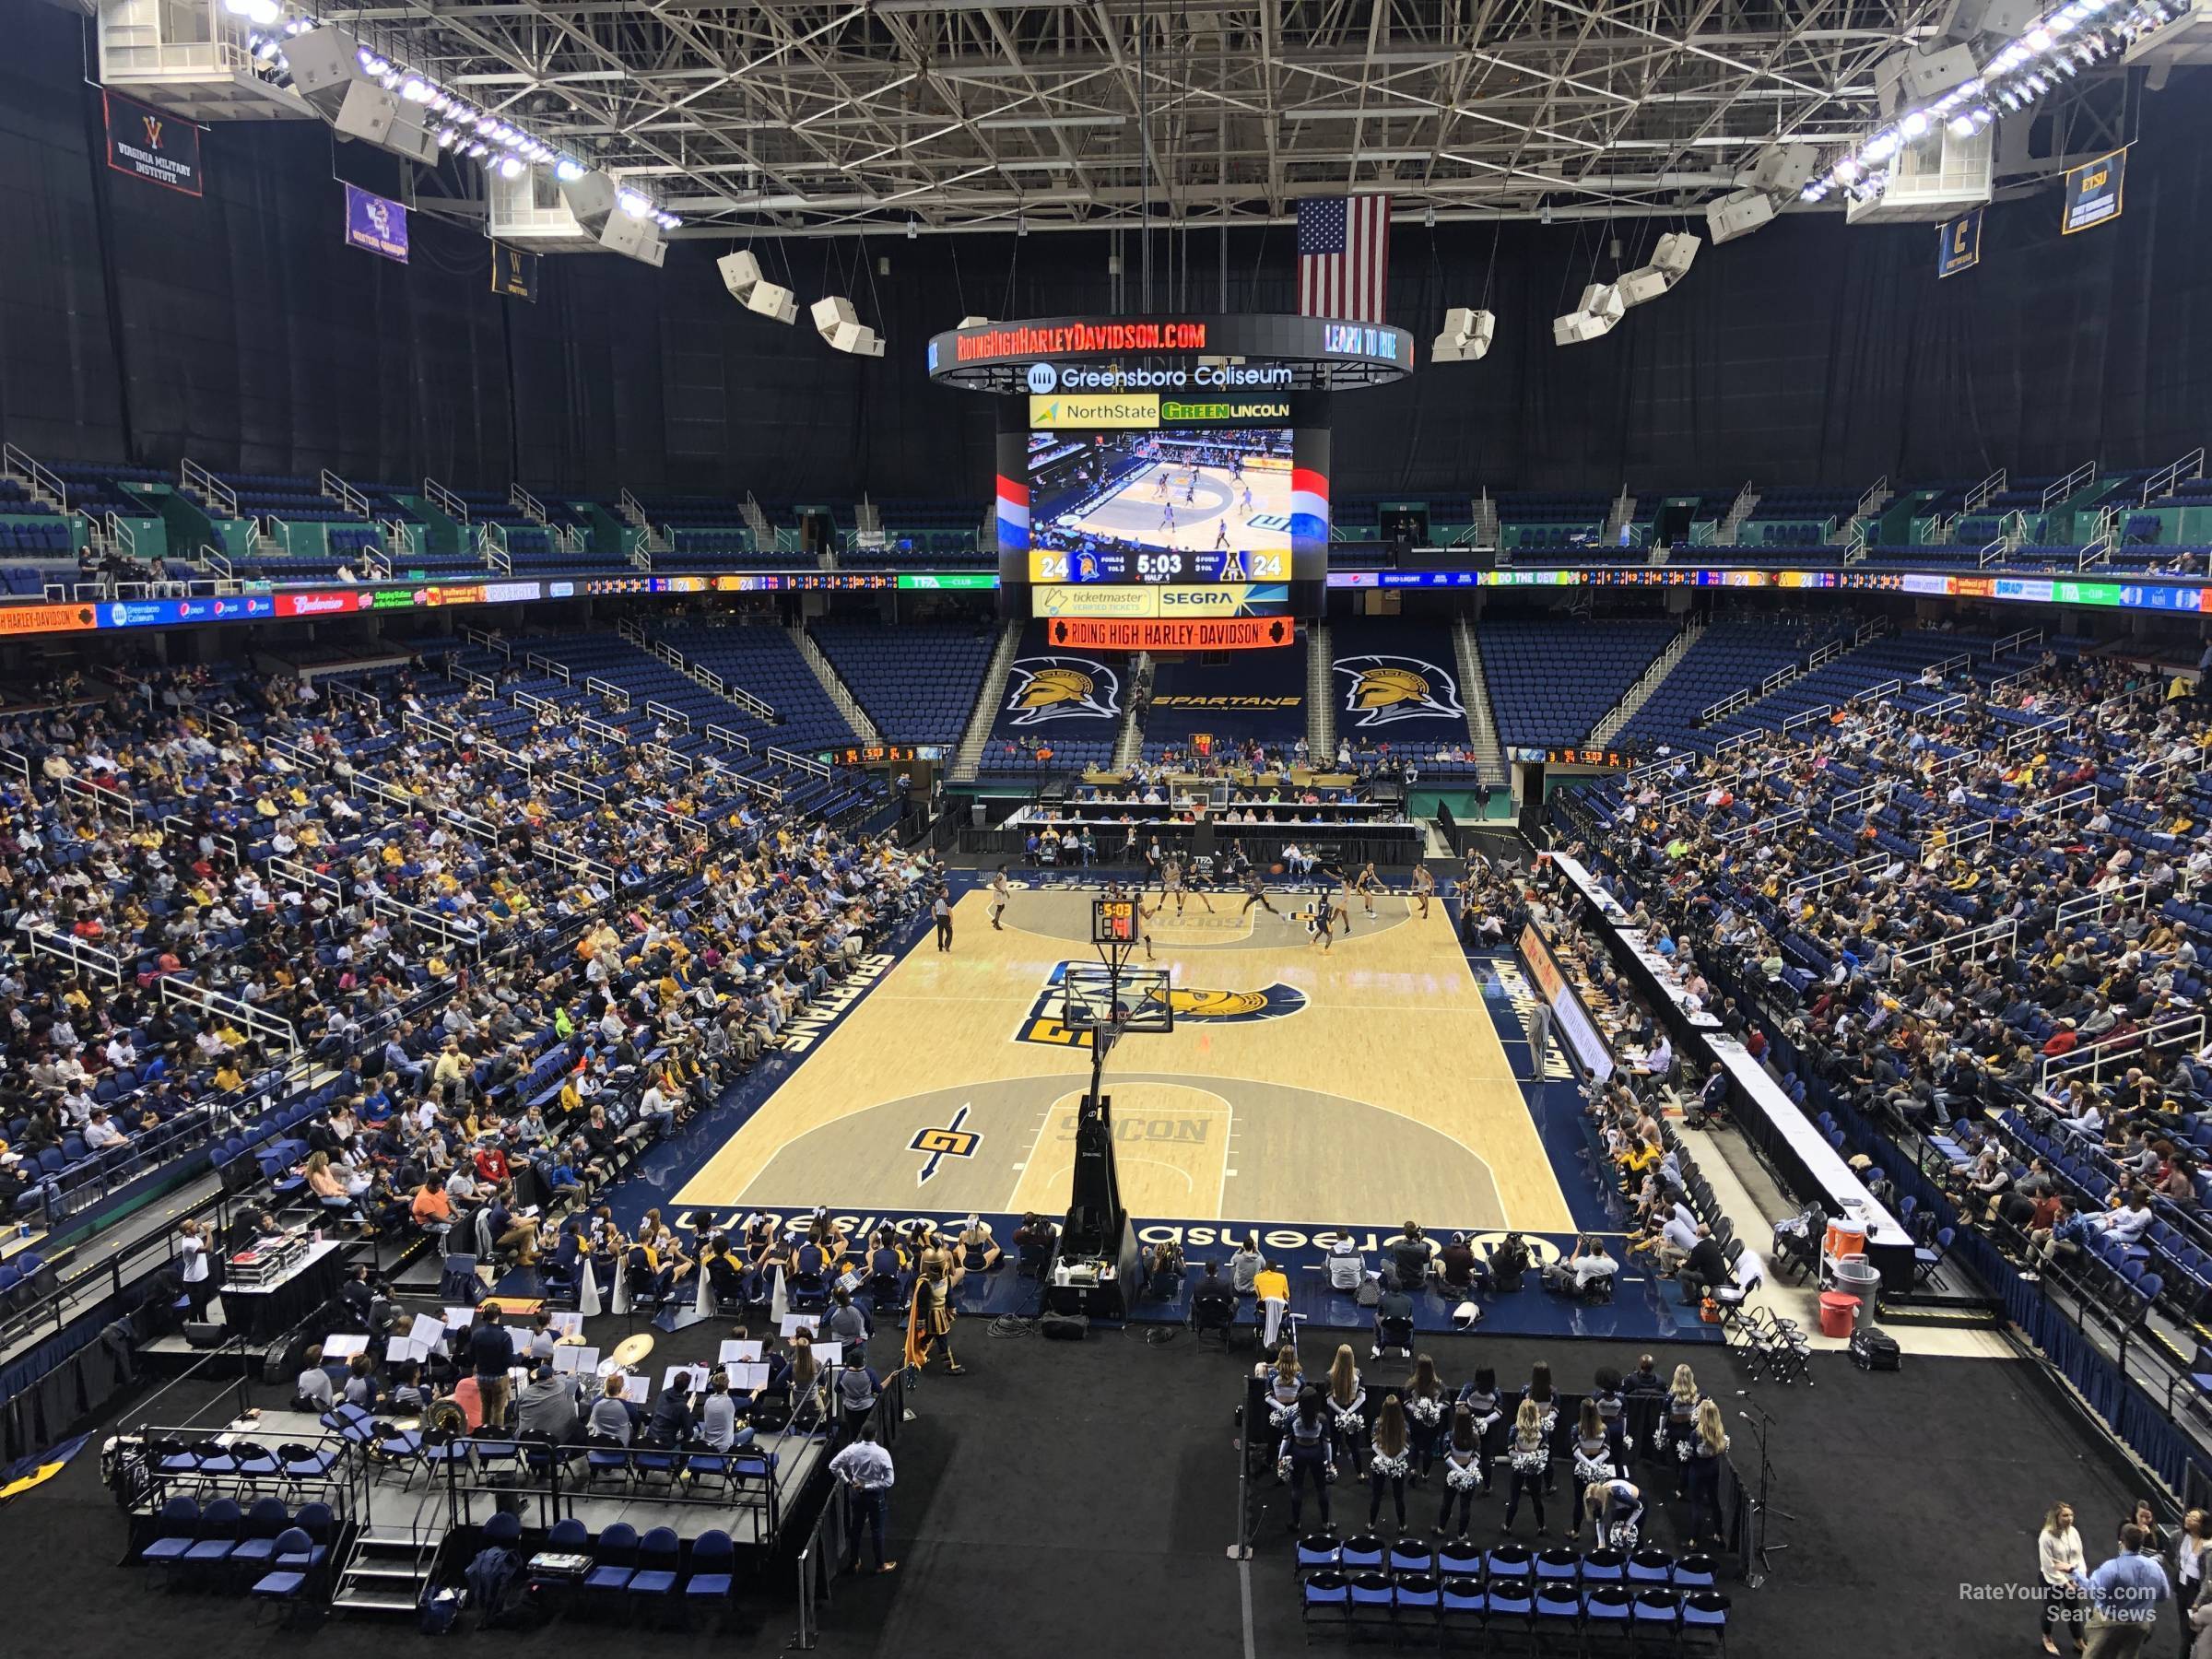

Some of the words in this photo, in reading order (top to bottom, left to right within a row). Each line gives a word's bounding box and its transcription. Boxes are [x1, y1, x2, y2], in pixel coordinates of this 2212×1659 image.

[118, 142, 154, 165] VIRGINIA
[155, 156, 191, 177] MILITARY
[135, 161, 177, 184] INSTITUTE
[2082, 171, 2108, 193] ETSU
[1325, 324, 1362, 354] LEARN
[1365, 329, 1377, 357] TO
[1379, 331, 1397, 359] RIDE
[1062, 368, 1187, 388] Greensboro
[1194, 365, 1292, 386] Coliseum
[1067, 405, 1157, 419] NorthState
[1161, 402, 1230, 420] GREEN
[1230, 403, 1290, 418] LINCOLN
[1041, 556, 1069, 579] 24
[1136, 554, 1182, 574] 5:03
[1253, 555, 1282, 577] 24
[790, 578, 795, 586] 0
[812, 578, 818, 586] 2
[855, 578, 865, 586] 20
[911, 576, 940, 588] TFA
[1499, 571, 1511, 583] DO
[1515, 571, 1535, 583] THE
[1537, 571, 1558, 583] DEW
[1582, 573, 1588, 582] 0
[1629, 573, 1638, 582] 13
[1653, 573, 1662, 582] 14
[1676, 574, 1685, 582] 21
[1735, 575, 1748, 586] 24
[1800, 575, 1812, 587] 24
[677, 582, 689, 591] 24
[739, 581, 753, 590] 24
[2002, 582, 2022, 594] BRADY
[295, 594, 344, 614] Budweiser
[1073, 592, 1144, 604] ticketmaster
[1162, 593, 1234, 605] SEGRA
[1073, 604, 1108, 612] VERIFIED
[1110, 604, 1141, 612] TICKETS
[1071, 623, 1106, 644] RIDING
[1109, 623, 1140, 644] HIGH
[1151, 696, 1302, 706] SPARTANS
[865, 748, 884, 757] 5:03
[908, 751, 913, 759] 3
[1549, 754, 1556, 763] 3
[1585, 752, 1603, 760] 5:03
[847, 755, 858, 763] 24
[1565, 755, 1575, 763] 24
[1609, 759, 1619, 767] 24
[1194, 856, 1215, 865] TFA
[1103, 903, 1132, 917] 5:03
[1112, 917, 1129, 939] 4
[1057, 1114, 1212, 1144] SCON
